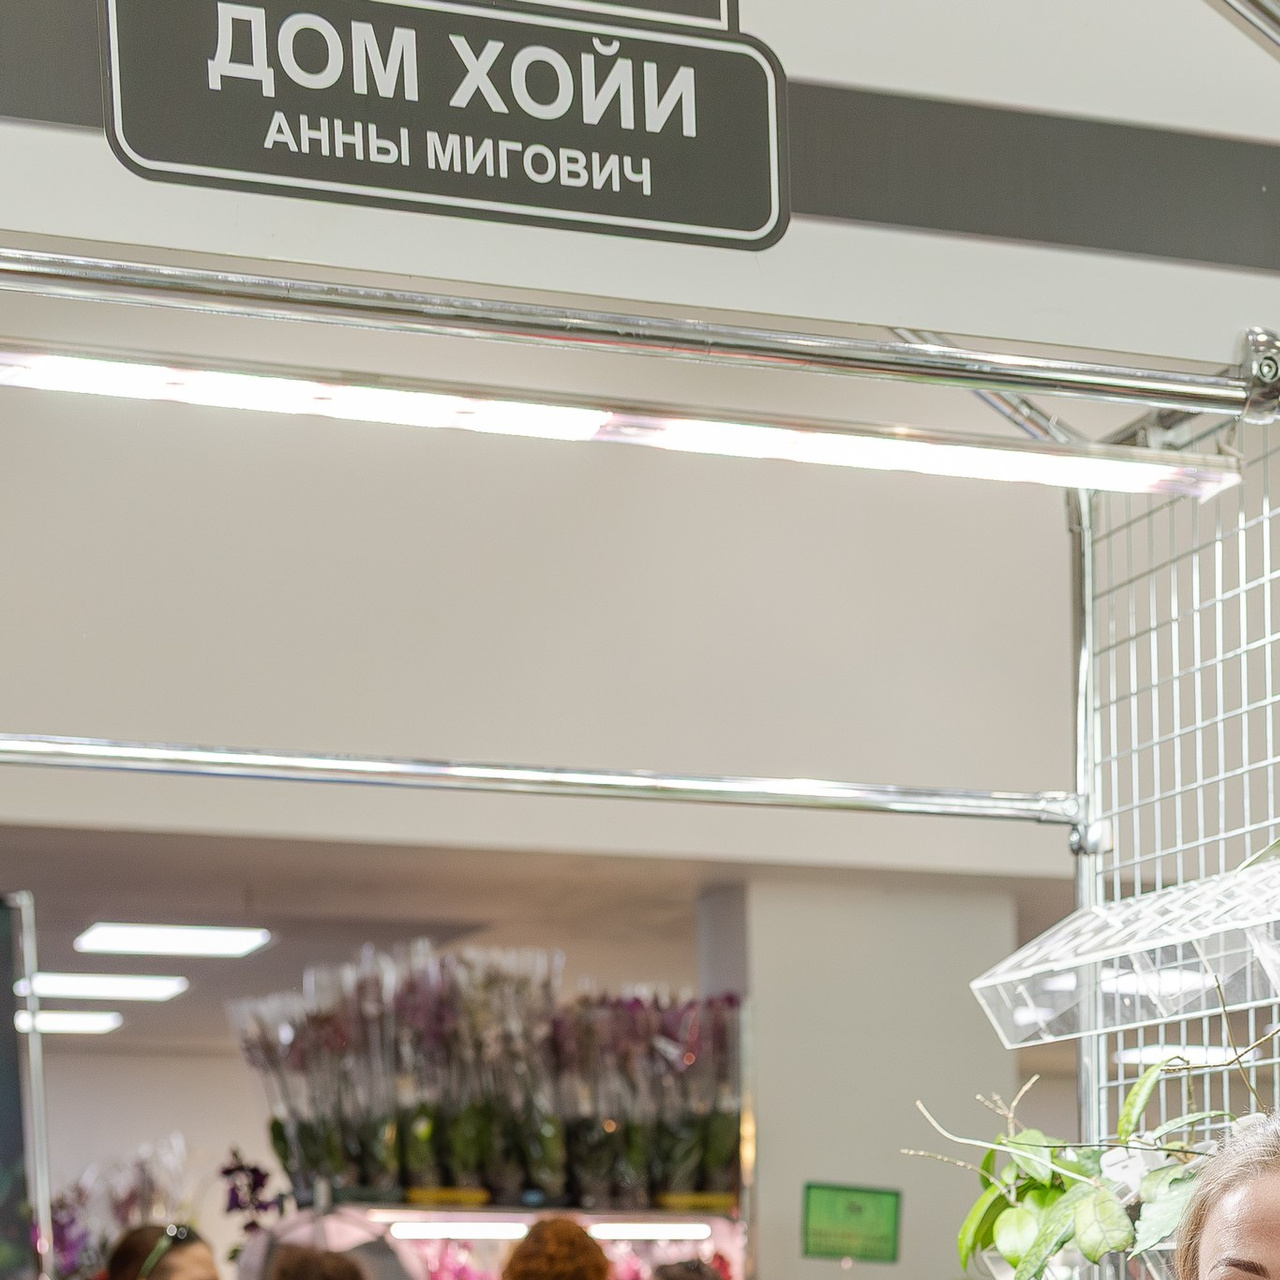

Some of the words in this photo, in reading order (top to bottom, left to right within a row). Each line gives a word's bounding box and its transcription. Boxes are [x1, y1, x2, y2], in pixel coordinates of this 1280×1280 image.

[207, 3, 419, 103] ДОМ
[449, 35, 698, 139] ХОЙИ
[263, 111, 411, 166] АННЫ
[426, 131, 654, 197] МИГОВИЧ
